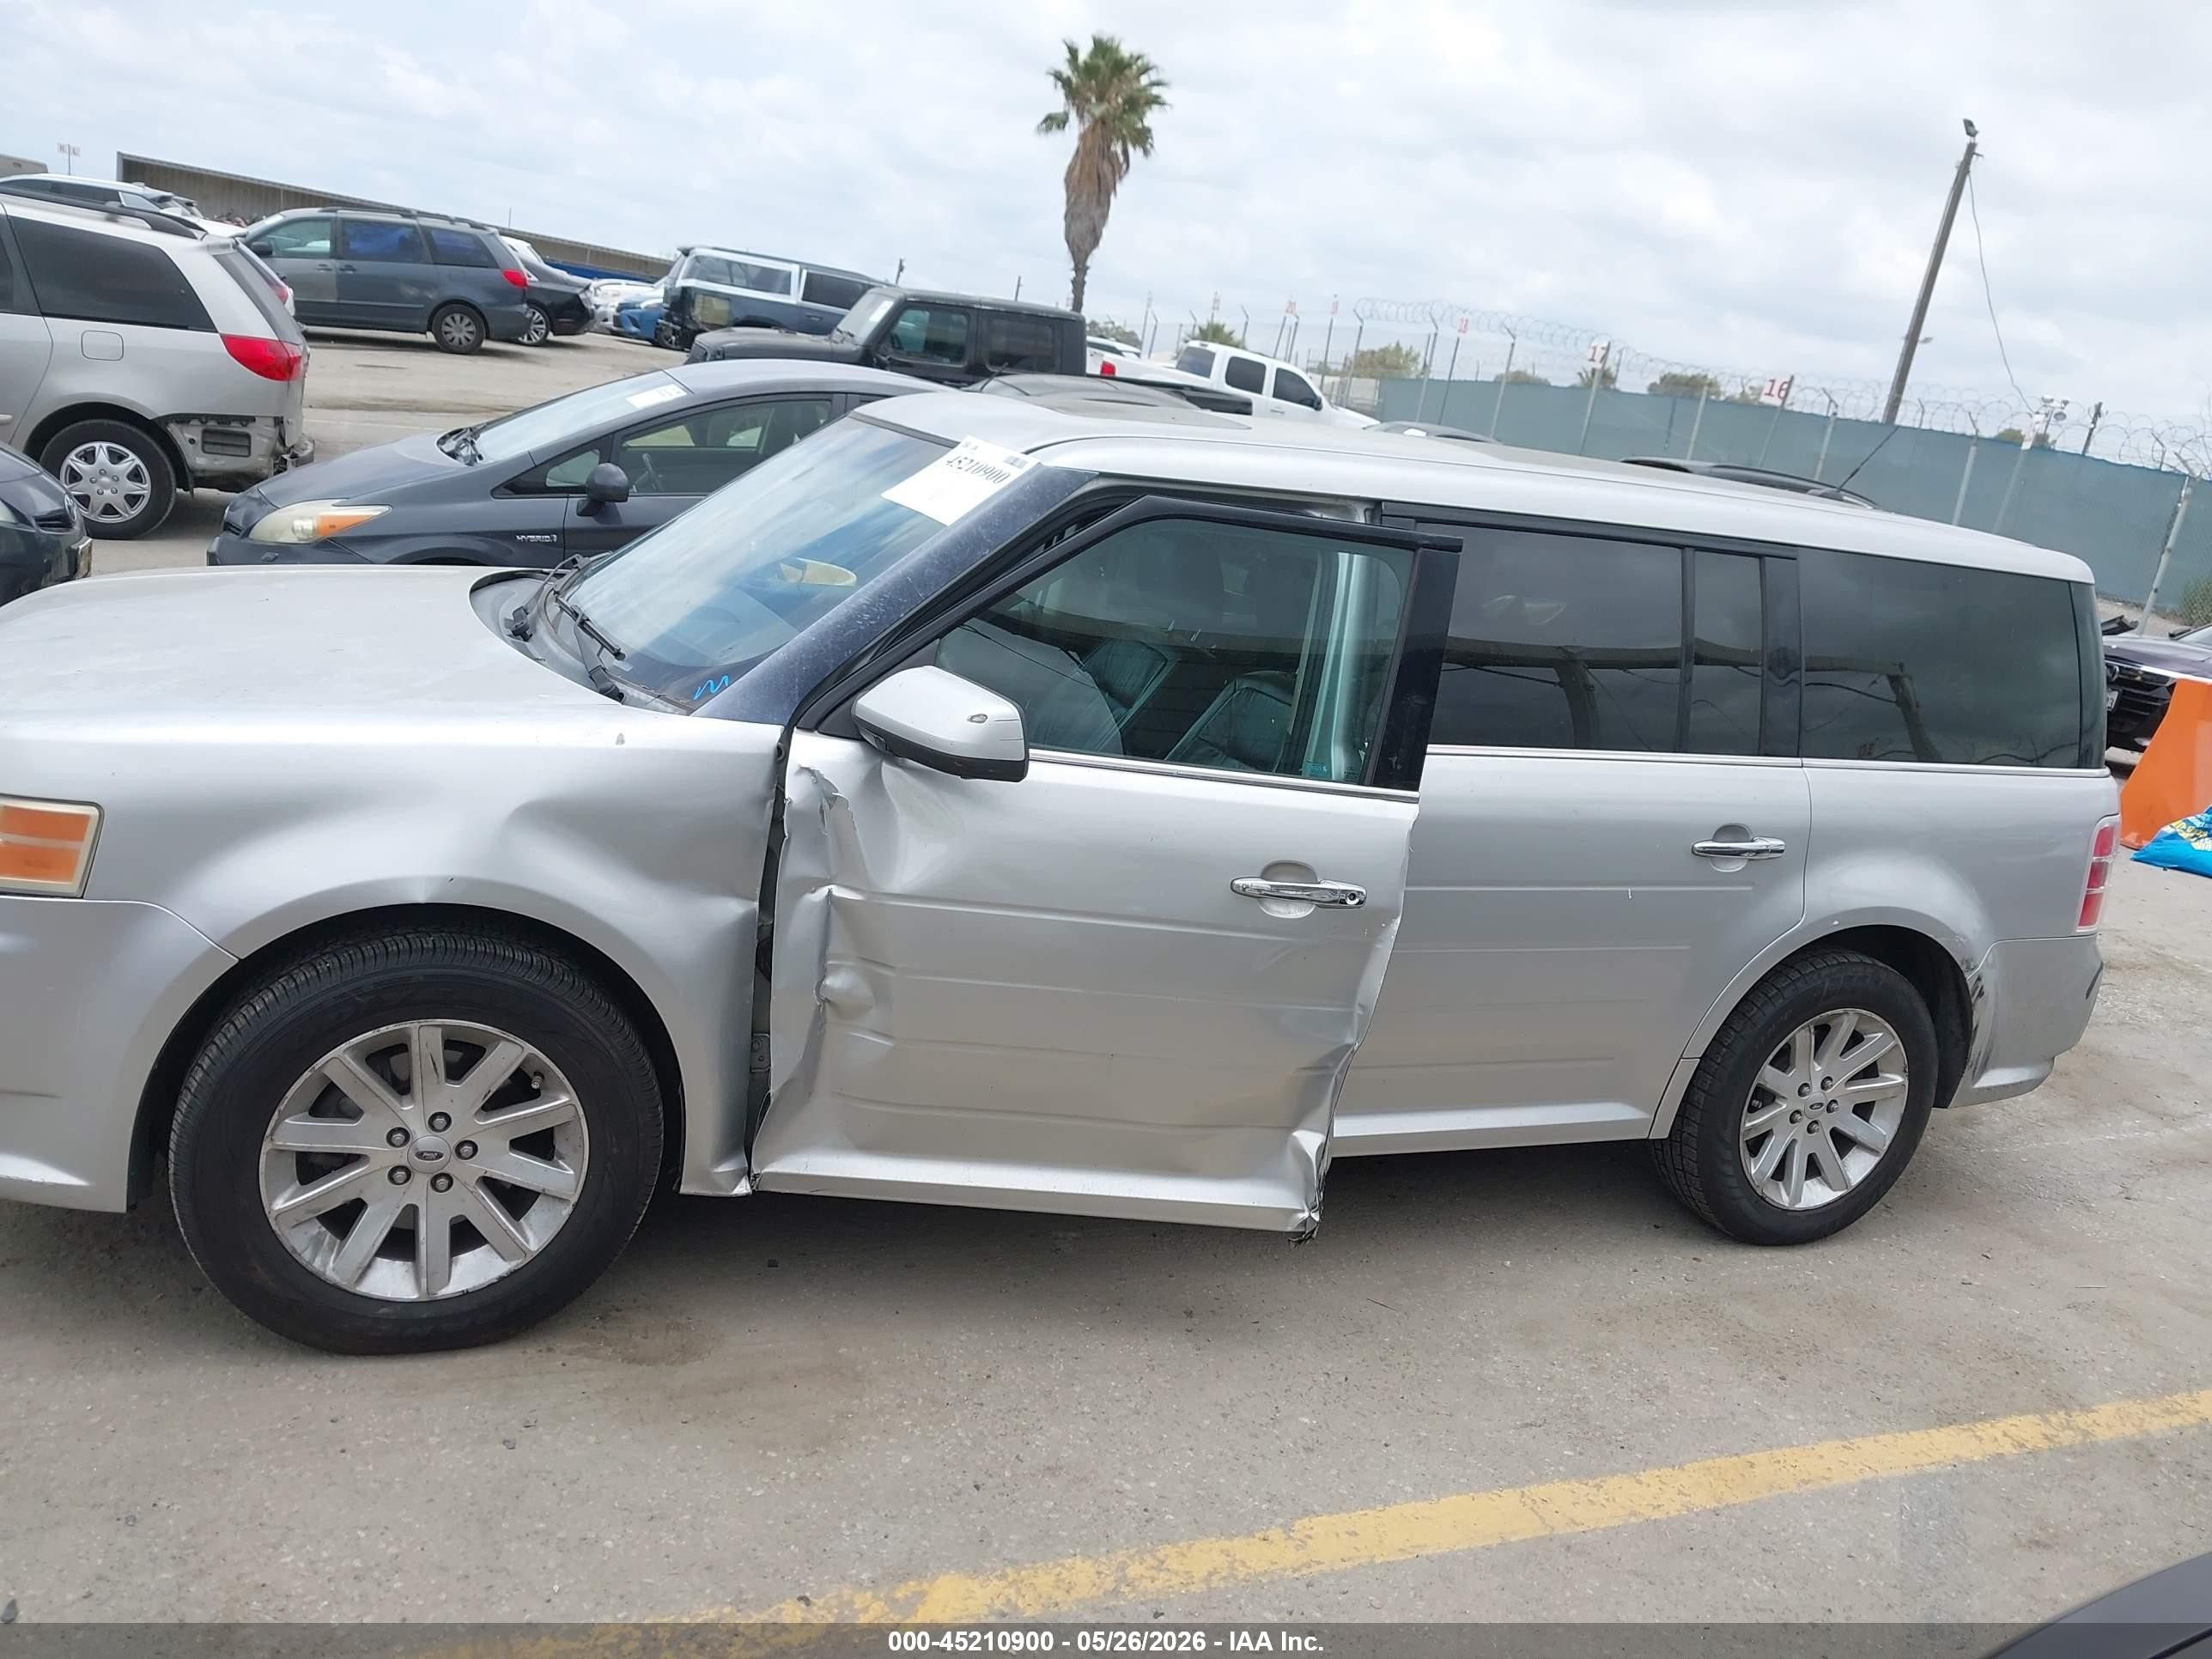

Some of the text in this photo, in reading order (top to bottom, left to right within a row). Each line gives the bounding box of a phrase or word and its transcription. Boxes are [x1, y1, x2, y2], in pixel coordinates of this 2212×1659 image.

[1588, 344, 1608, 363] 17
[1764, 379, 1789, 399] 16
[515, 534, 552, 543] HYBRID
